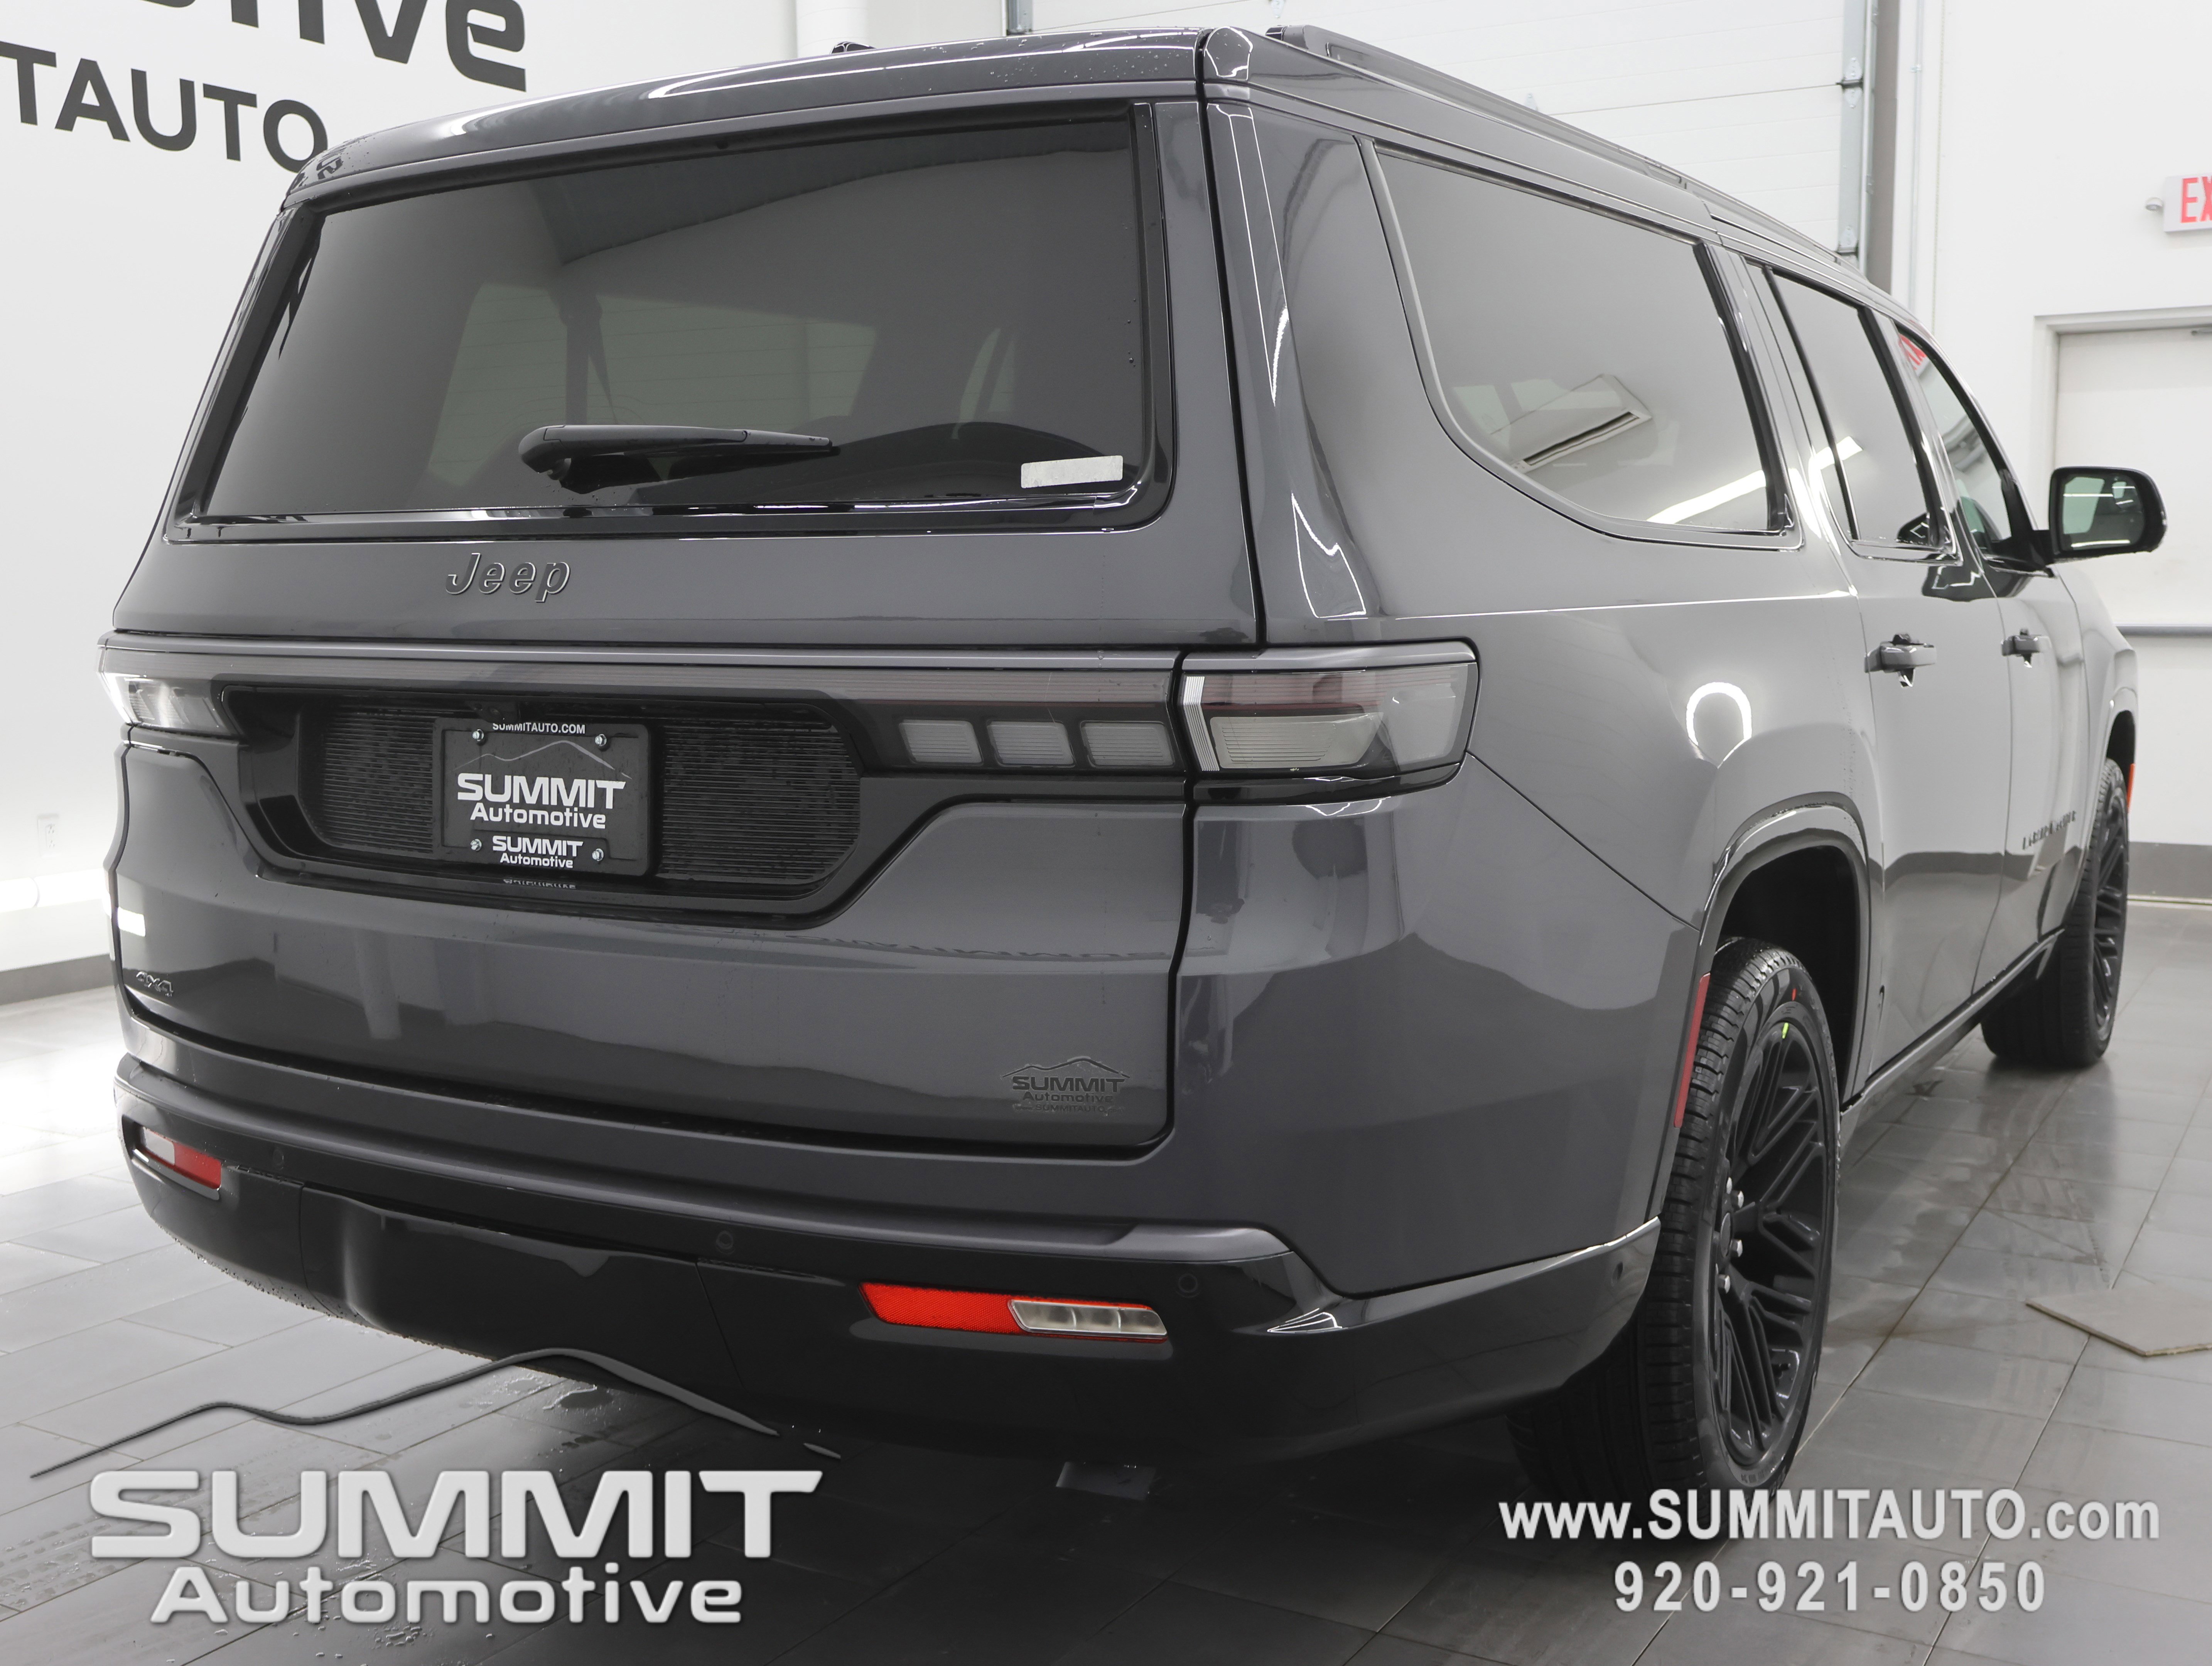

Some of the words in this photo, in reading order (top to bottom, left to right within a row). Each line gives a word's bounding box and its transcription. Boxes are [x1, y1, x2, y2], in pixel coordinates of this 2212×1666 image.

[445, 552, 570, 603] Jeep
[493, 722, 585, 734] SUMMITAUTO.COM
[457, 772, 626, 809] SUMMIT
[470, 802, 606, 829] Automotive
[492, 835, 584, 857] SUMMIT
[500, 852, 574, 868] Automotive
[1012, 1076, 1125, 1092] SUMMIT
[1022, 1091, 1114, 1103] Automotive
